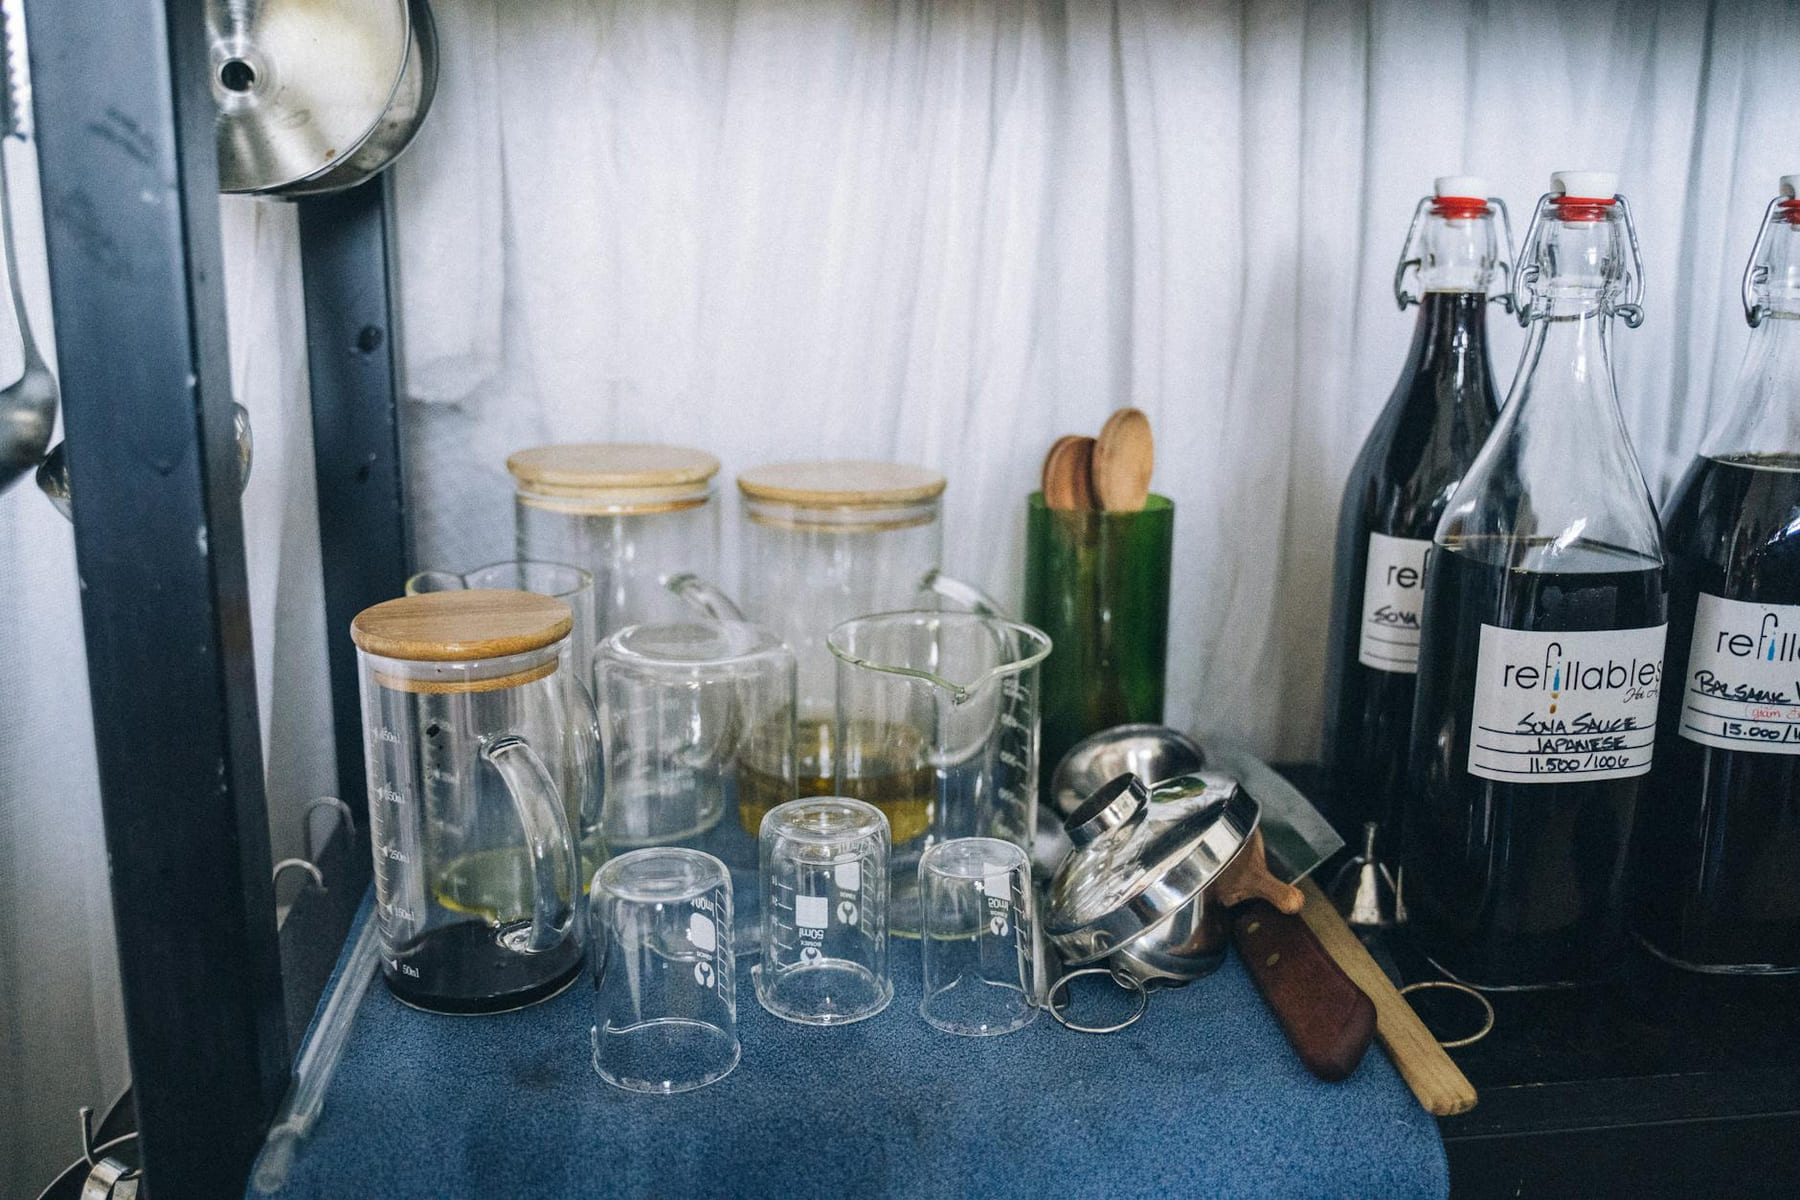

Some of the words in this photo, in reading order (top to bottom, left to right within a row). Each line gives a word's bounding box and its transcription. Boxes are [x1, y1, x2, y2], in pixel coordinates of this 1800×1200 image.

[1717, 613, 1800, 662] refill
[1515, 712, 1567, 735] SOYA
[1571, 712, 1638, 735] SAUCE
[1722, 722, 1800, 743] 15.000/1
[381, 728, 401, 745] 50ml
[1528, 735, 1628, 754] JAPANESE
[798, 927, 825, 940] 50ml
[401, 962, 420, 979] 50ml
